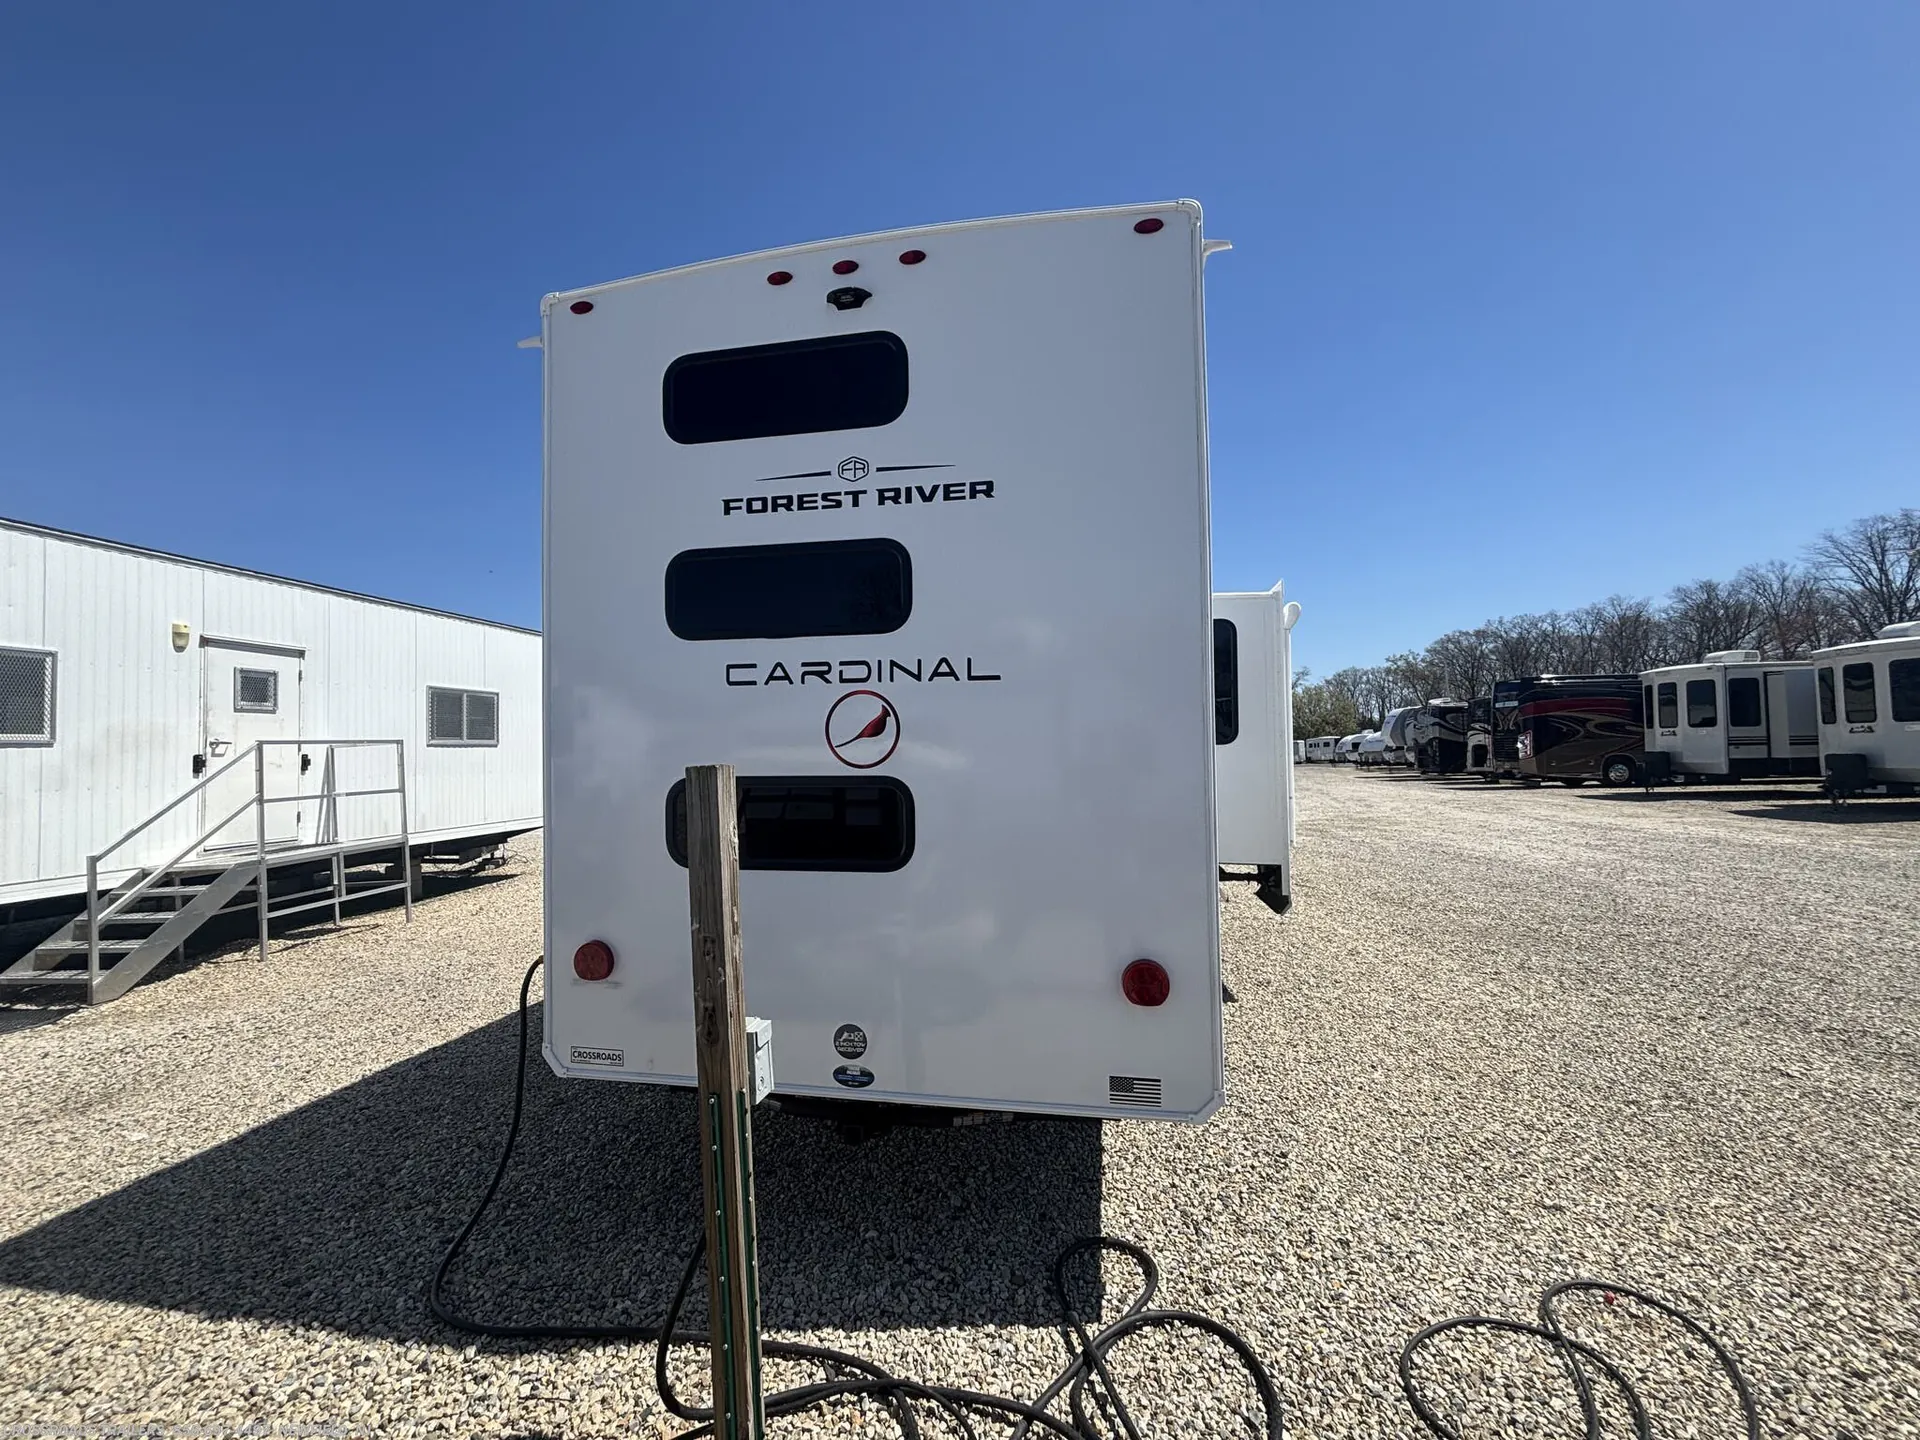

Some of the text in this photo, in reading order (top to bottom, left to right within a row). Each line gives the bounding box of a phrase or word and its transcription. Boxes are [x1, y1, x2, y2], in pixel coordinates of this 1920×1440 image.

[721, 480, 995, 516] FOREST RIVER
[725, 657, 1002, 687] CARDINAL
[572, 1050, 622, 1062] CROSSROADS
